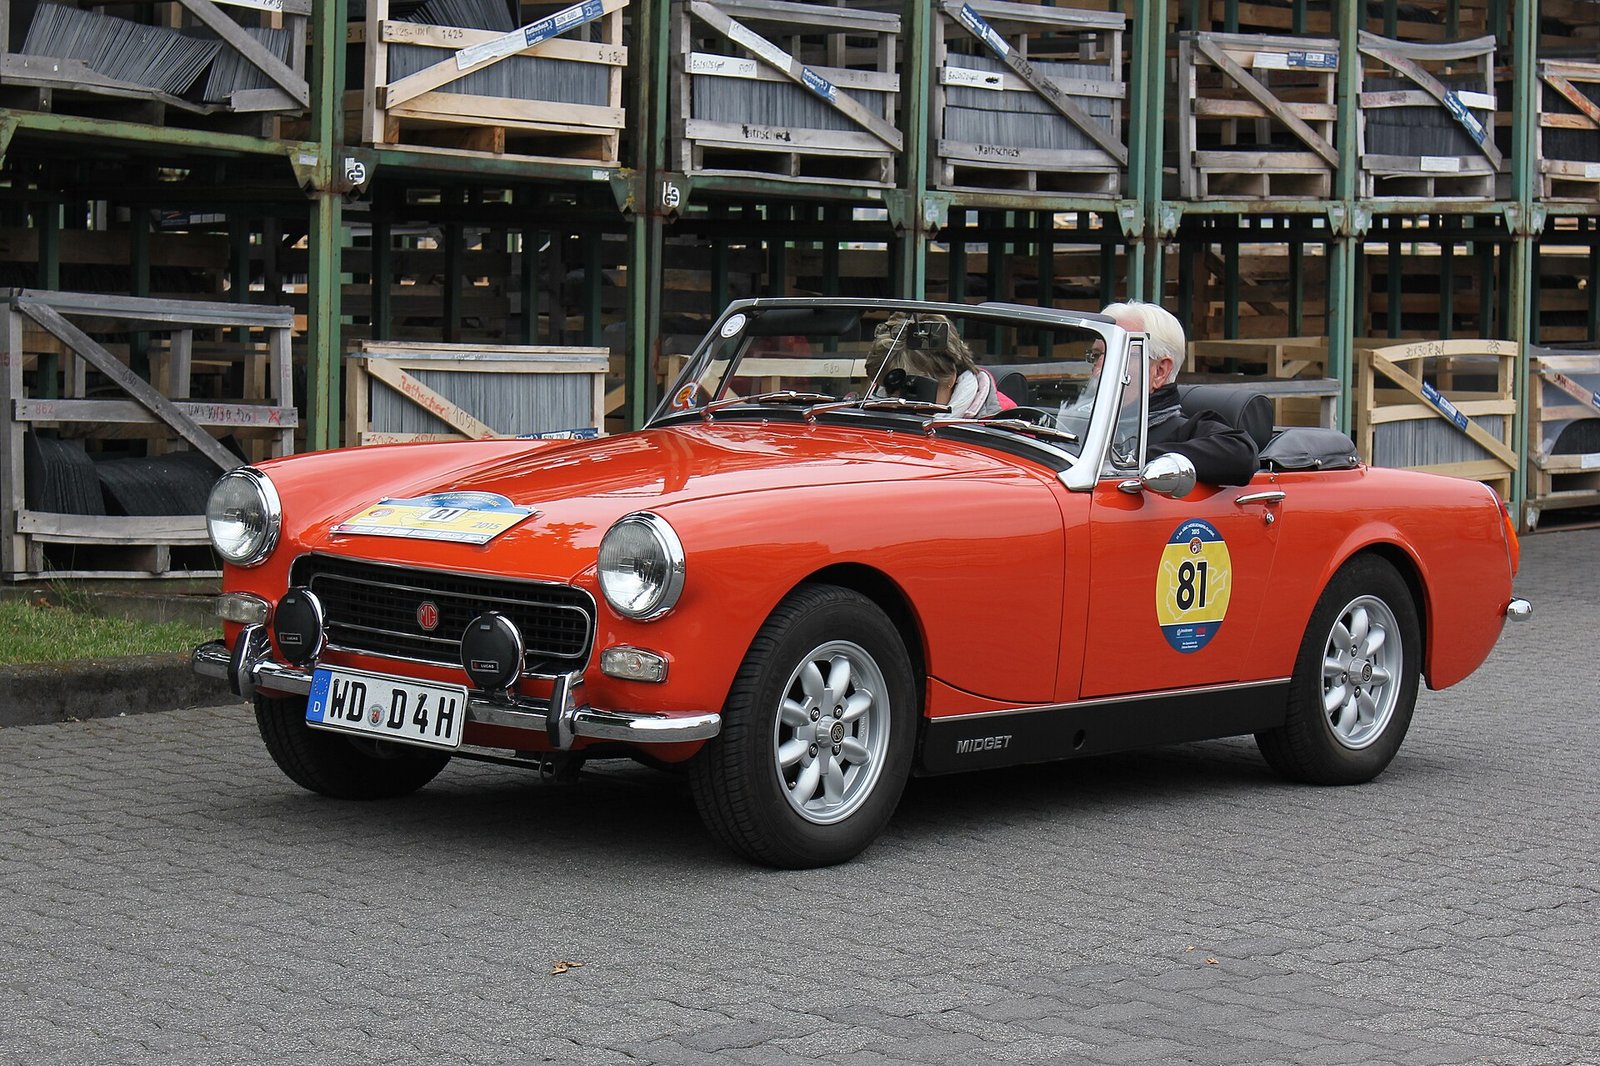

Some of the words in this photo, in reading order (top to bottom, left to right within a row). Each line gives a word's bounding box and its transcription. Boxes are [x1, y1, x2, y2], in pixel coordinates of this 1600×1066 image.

[1176, 561, 1208, 611] 81
[420, 605, 437, 627] MG
[313, 701, 321, 712] D
[330, 678, 367, 722] WD
[956, 735, 1013, 754] MIDGET
